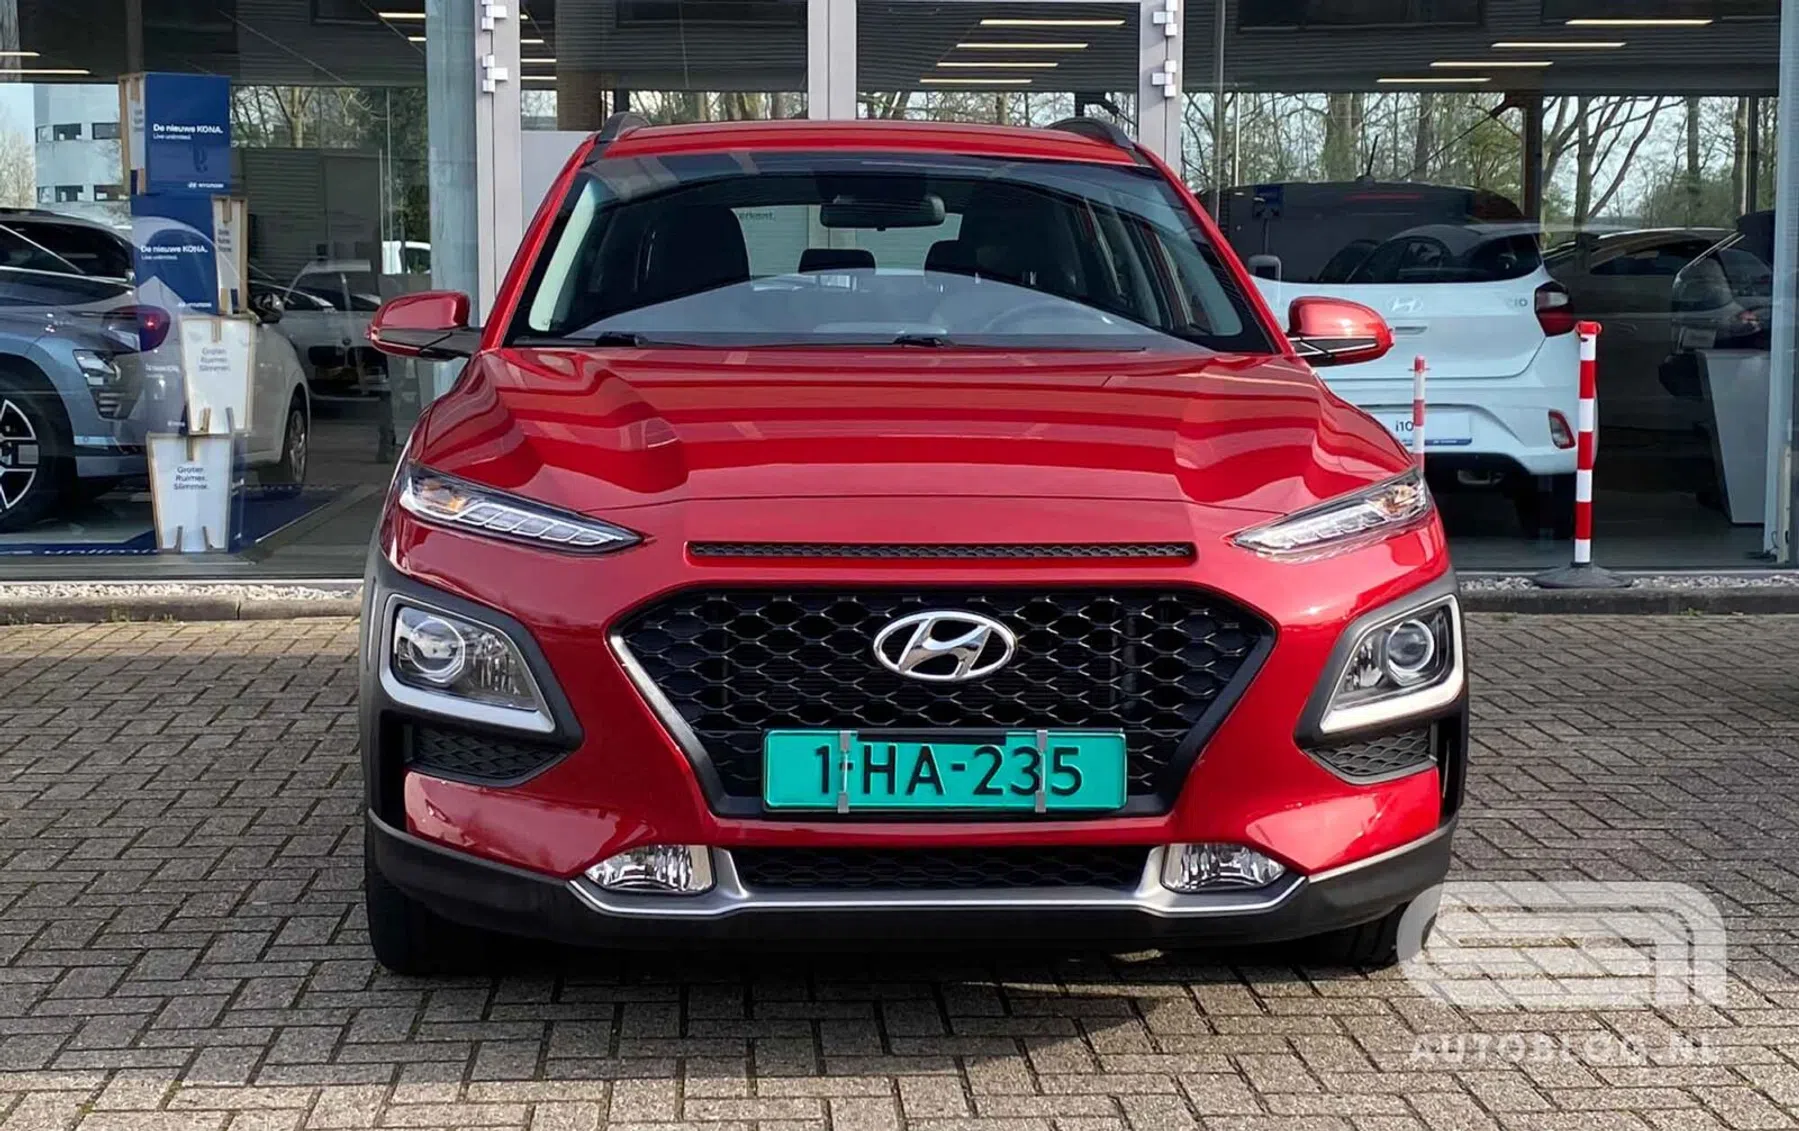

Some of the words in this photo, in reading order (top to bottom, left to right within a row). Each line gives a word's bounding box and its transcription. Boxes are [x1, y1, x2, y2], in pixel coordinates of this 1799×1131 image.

[152, 123, 165, 132] De
[166, 124, 196, 132] nieuwe
[140, 245, 152, 253] De
[1395, 419, 1415, 432] i10
[814, 744, 1083, 797] 1-HA-235
